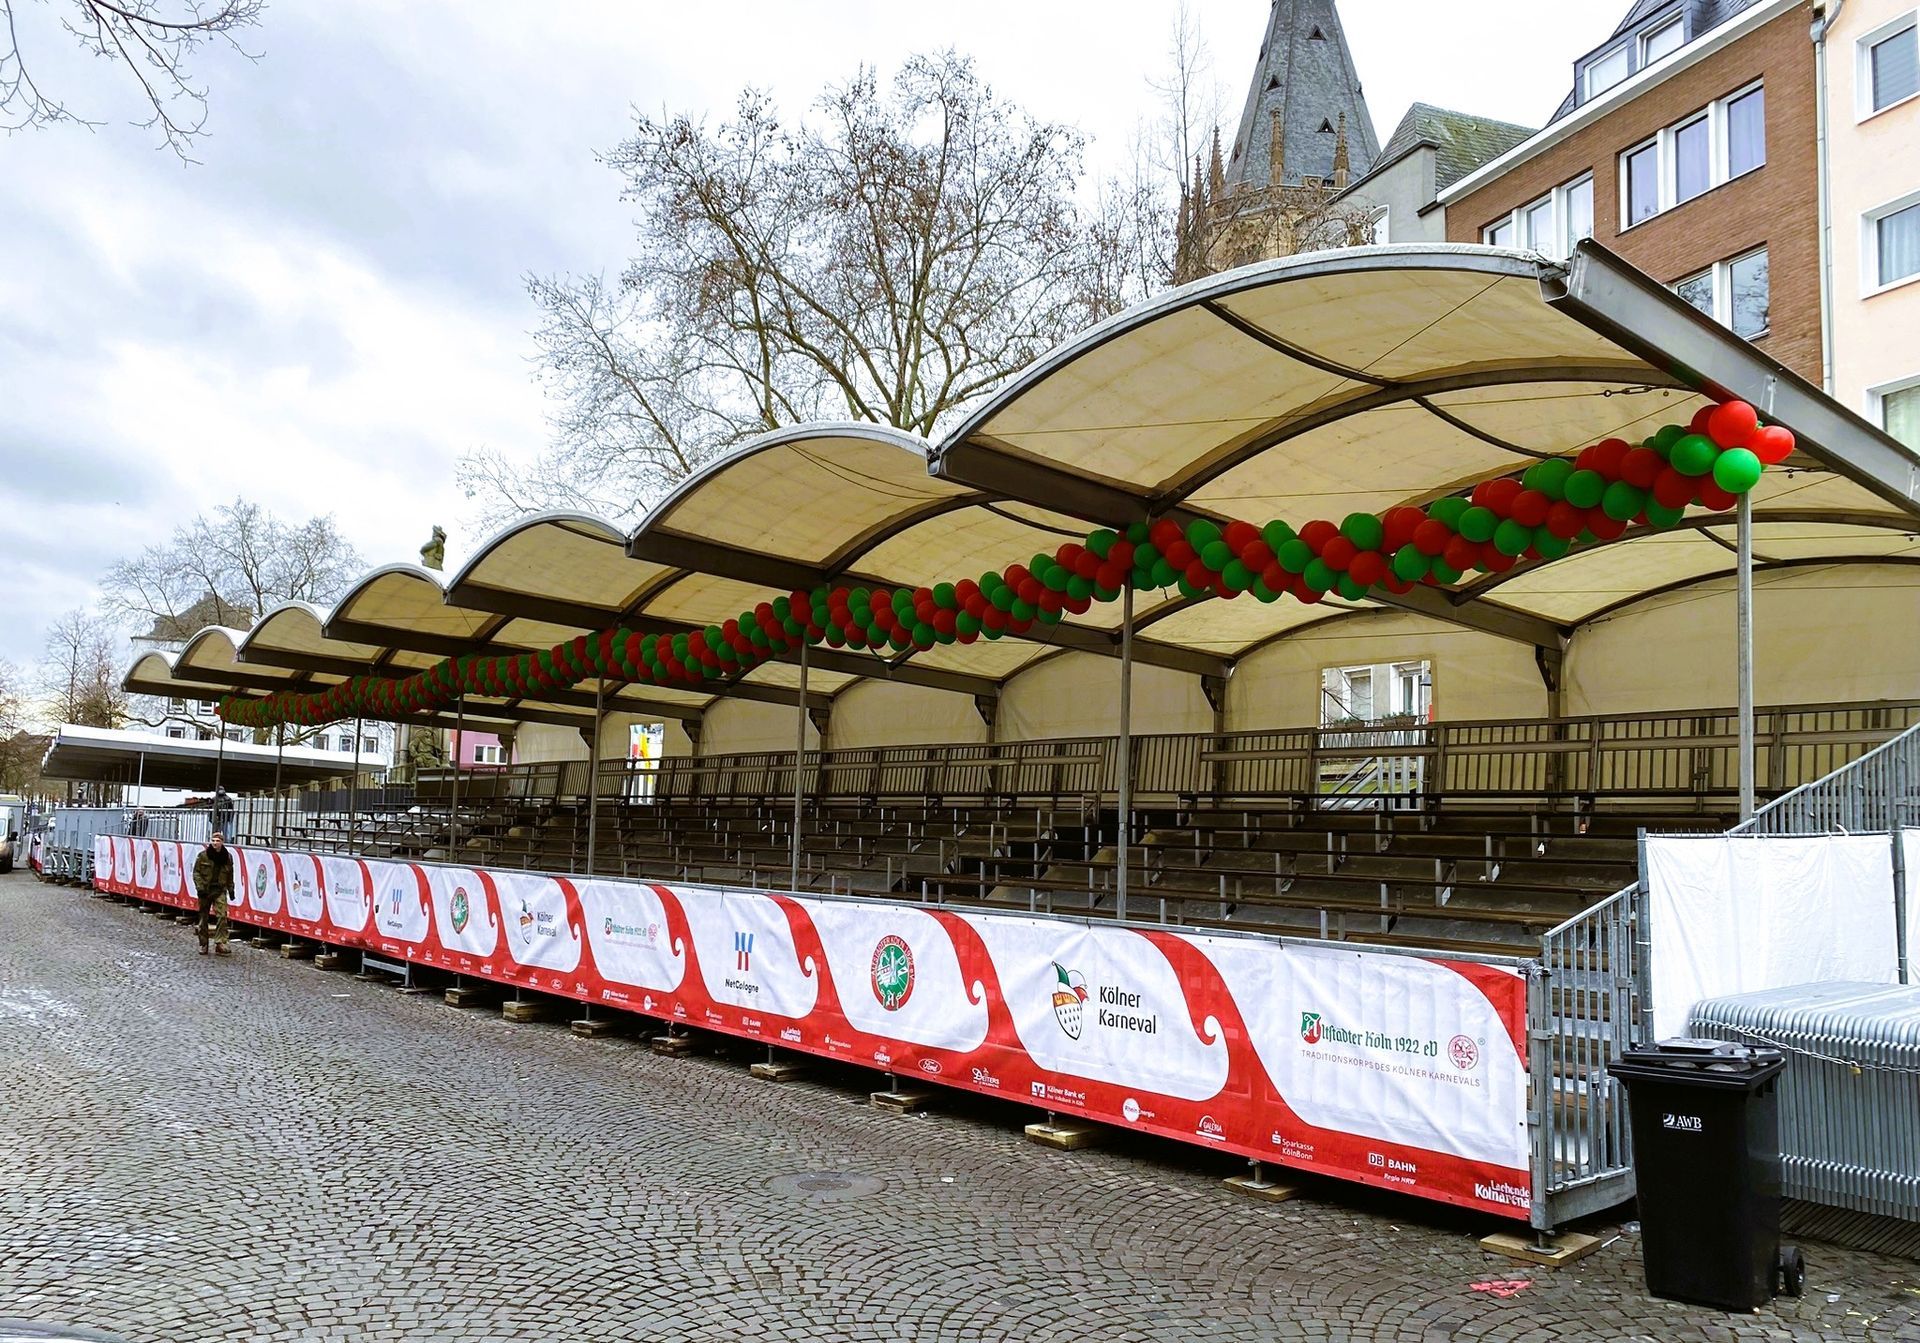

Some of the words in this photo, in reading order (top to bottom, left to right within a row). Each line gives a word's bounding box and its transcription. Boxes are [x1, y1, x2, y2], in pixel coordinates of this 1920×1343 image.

[725, 978, 759, 994] NetCologne
[1099, 985, 1141, 1009] Kölner
[1099, 1008, 1157, 1035] Karneval
[1365, 1031, 1393, 1051] Köln
[1394, 1037, 1420, 1055] 1922
[1423, 1040, 1439, 1057] eV
[1301, 1049, 1375, 1071] TRADITIONSKORPS
[1374, 1062, 1391, 1073] DES
[1428, 1071, 1481, 1088] KARNEVALS
[1065, 1088, 1078, 1098] Bank
[1676, 1115, 1703, 1129] AWB
[1282, 1138, 1314, 1152] Sparkasse
[1282, 1147, 1313, 1160] KölnBonn
[1369, 1153, 1384, 1167] DB
[1388, 1158, 1417, 1173] BAHN
